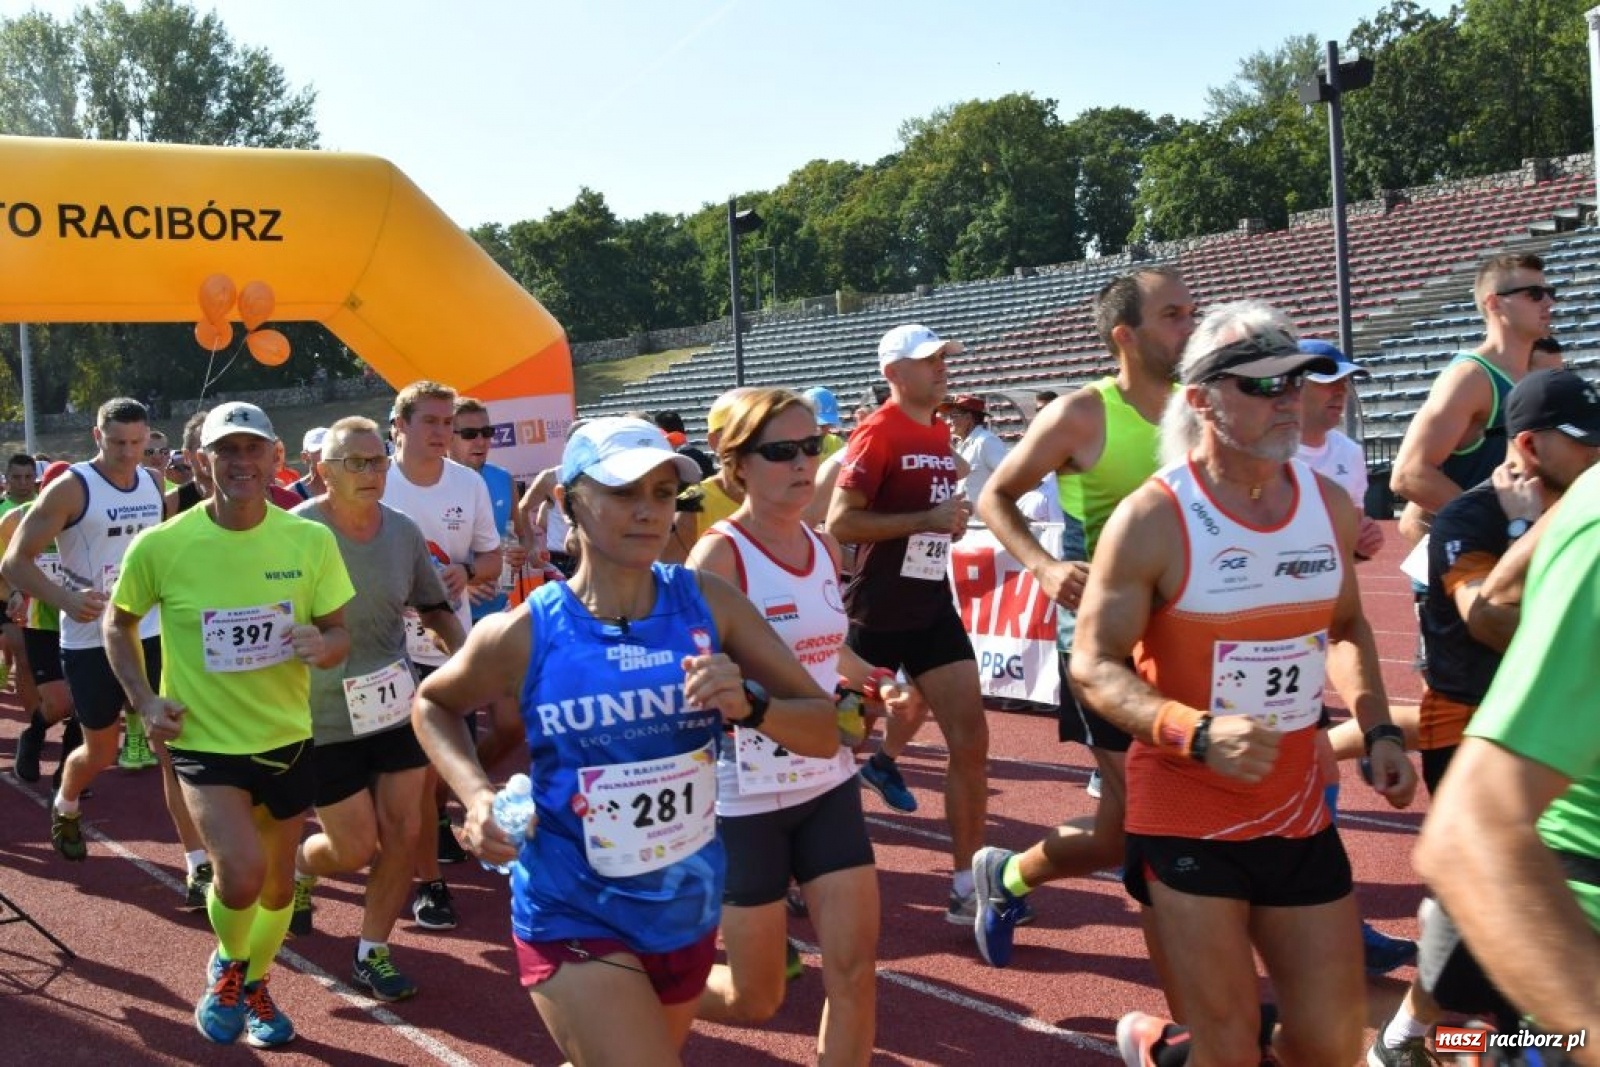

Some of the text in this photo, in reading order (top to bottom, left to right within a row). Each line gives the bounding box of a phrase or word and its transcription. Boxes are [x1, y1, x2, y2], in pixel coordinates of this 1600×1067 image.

[0, 200, 283, 241] O RACIBÓRZ
[1190, 502, 1220, 536] deep
[231, 621, 274, 647] 397
[795, 633, 843, 652] CROSS
[979, 650, 1024, 680] PBG
[1266, 664, 1300, 697] 32
[377, 681, 397, 704] 71
[631, 782, 694, 828] 281
